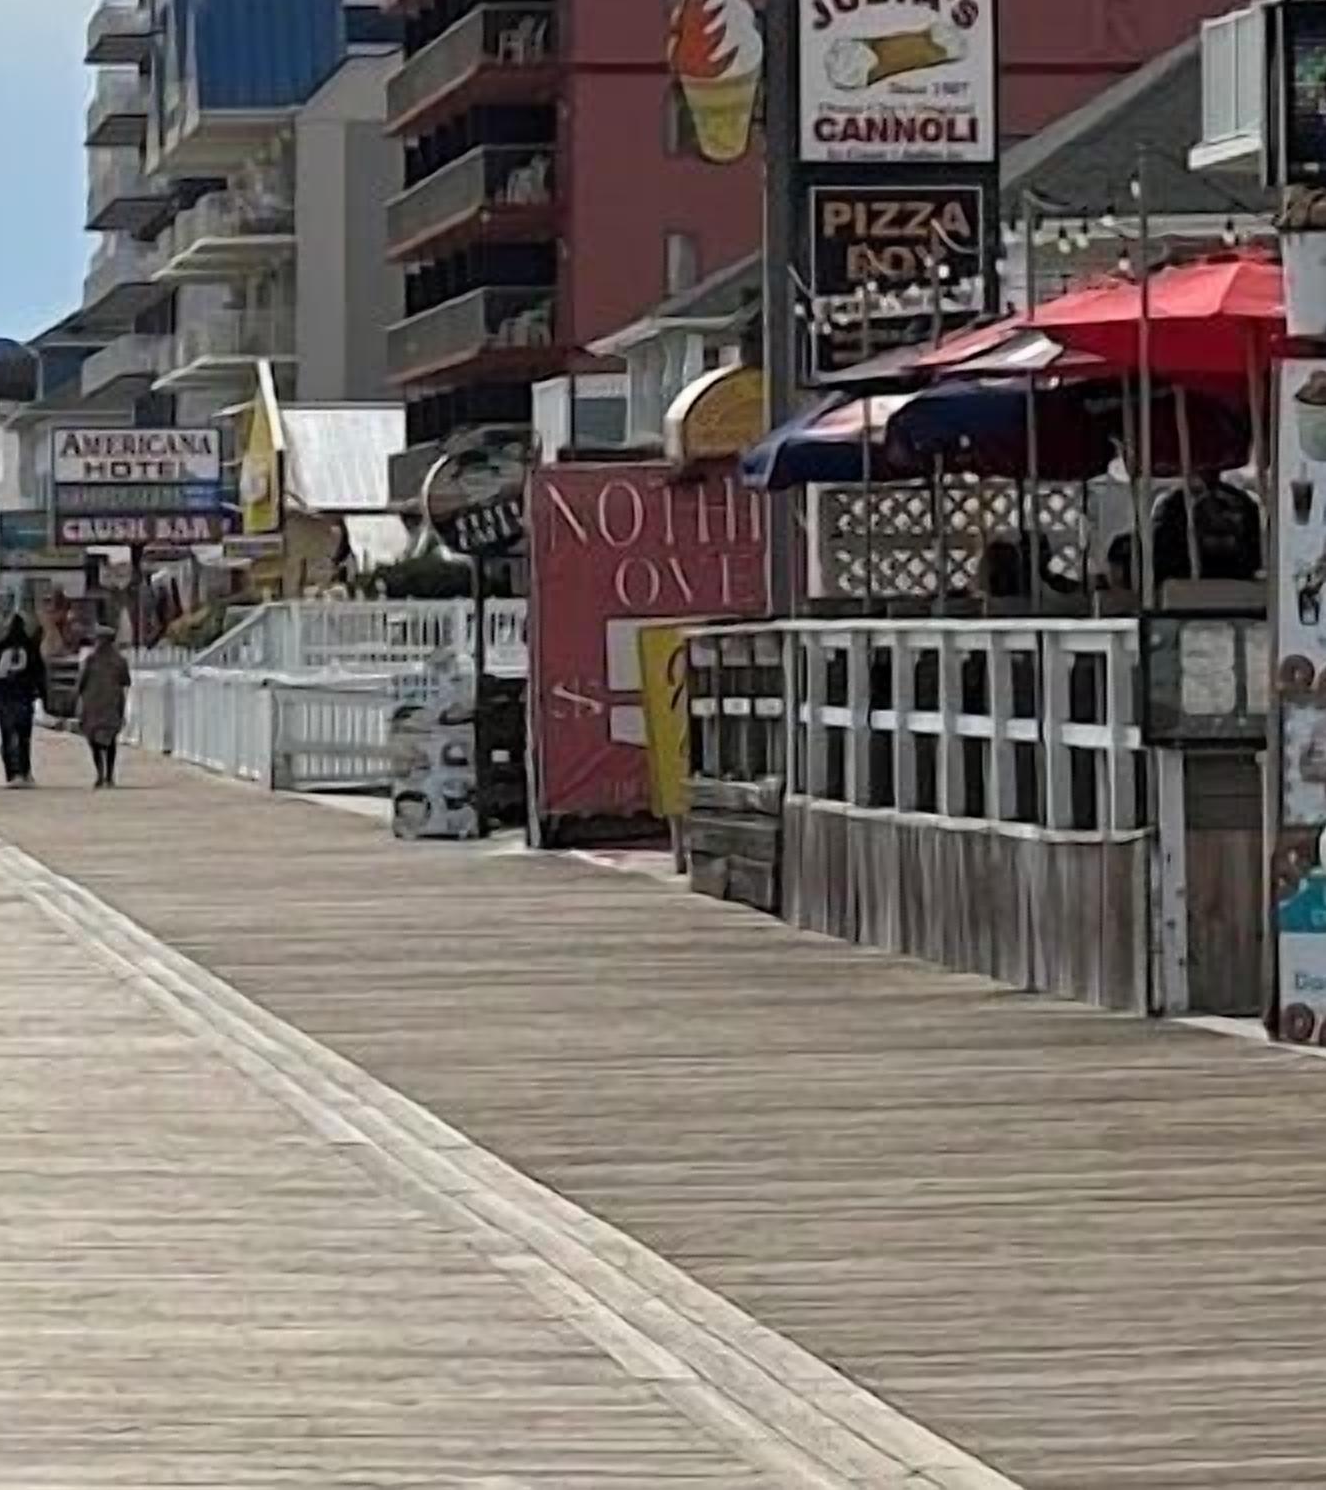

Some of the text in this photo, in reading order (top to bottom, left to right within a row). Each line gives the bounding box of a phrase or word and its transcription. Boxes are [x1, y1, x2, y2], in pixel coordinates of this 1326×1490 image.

[813, 117, 979, 143] CANNOLI
[823, 200, 972, 238] PIZZA
[60, 432, 212, 457] AMERICANA
